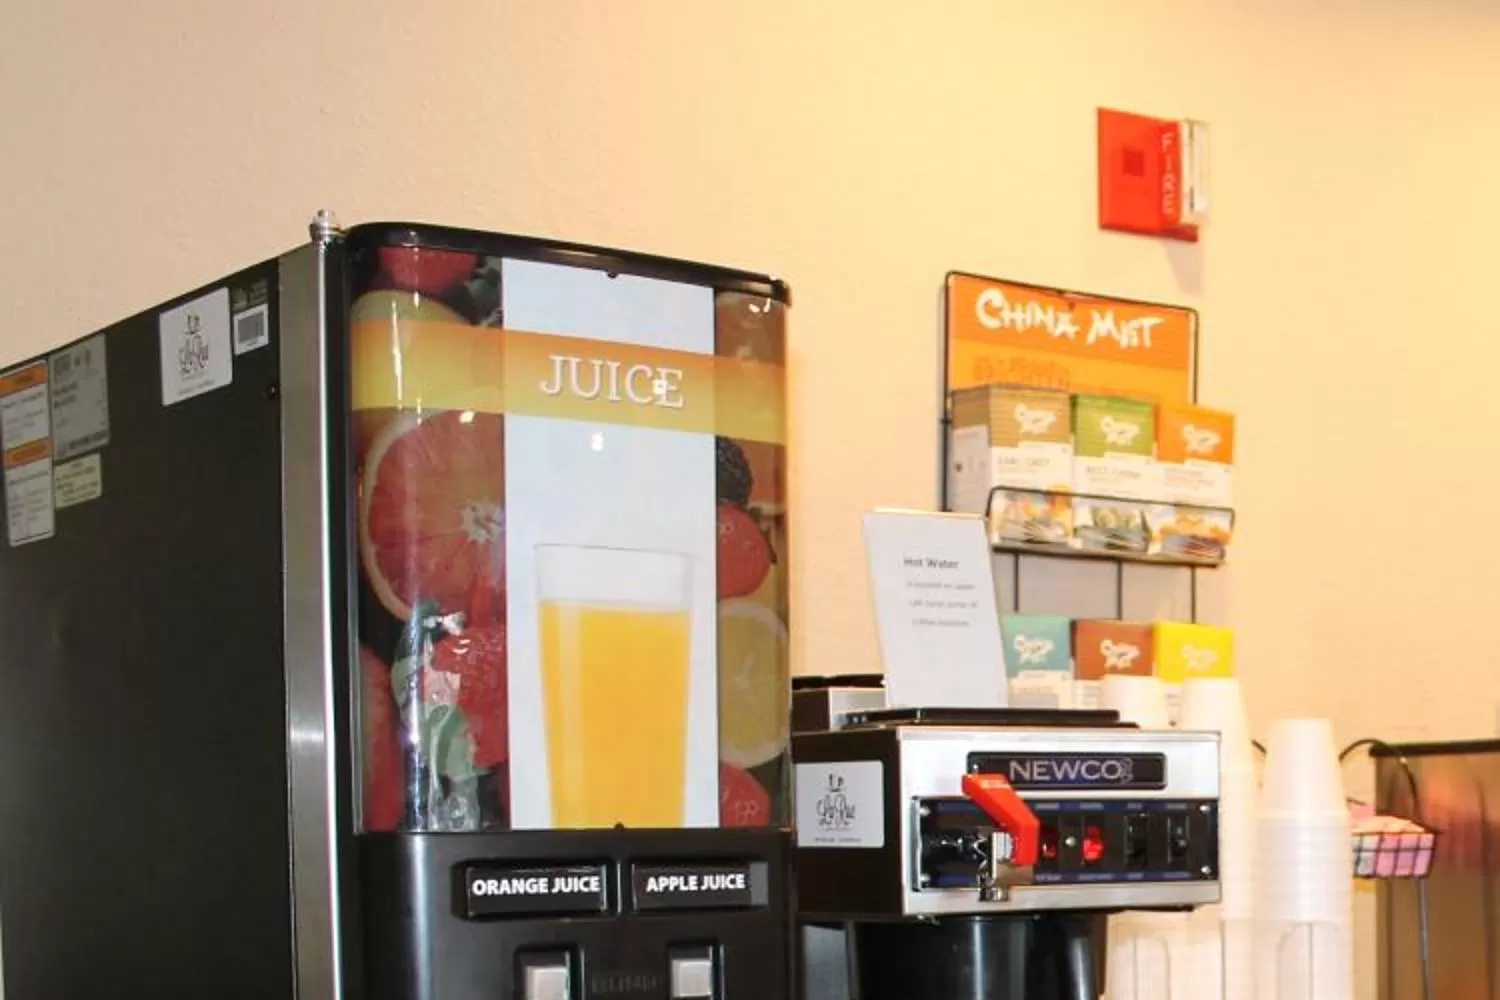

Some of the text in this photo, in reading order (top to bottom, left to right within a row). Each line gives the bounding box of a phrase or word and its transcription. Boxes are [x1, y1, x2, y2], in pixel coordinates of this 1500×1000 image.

[539, 354, 684, 408] JUICE
[1009, 759, 1122, 781] NEWCO
[472, 875, 601, 896] ORANGE JUICE
[646, 873, 746, 892] APPLE JUICE
